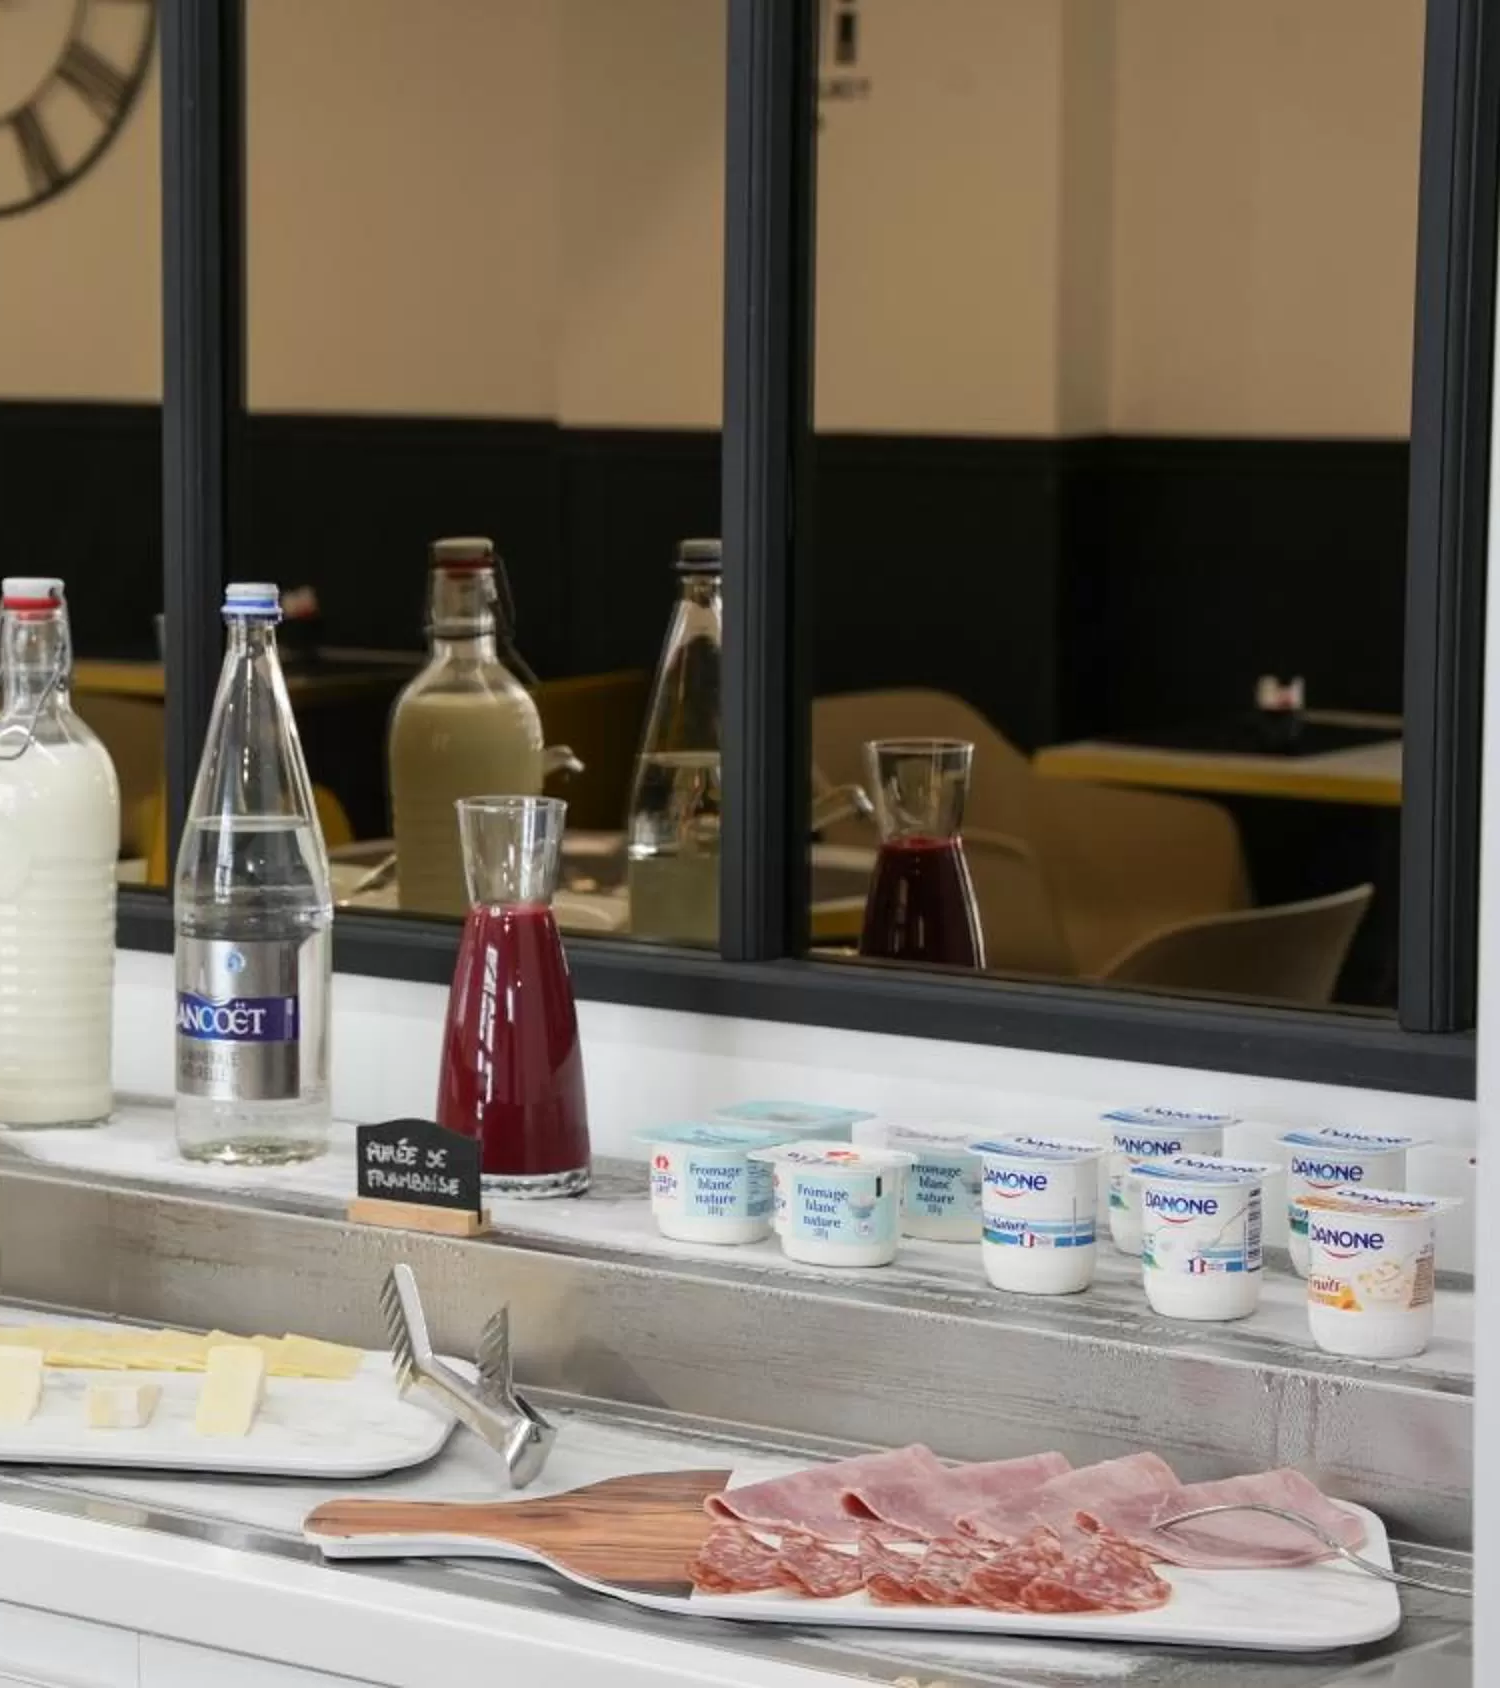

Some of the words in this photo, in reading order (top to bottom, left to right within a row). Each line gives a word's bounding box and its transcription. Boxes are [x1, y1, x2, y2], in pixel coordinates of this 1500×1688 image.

[689, 1162, 743, 1178] Fromage
[797, 1183, 849, 1203] Fromage
[805, 1199, 838, 1214] blanc
[1145, 1190, 1219, 1216] DANONE
